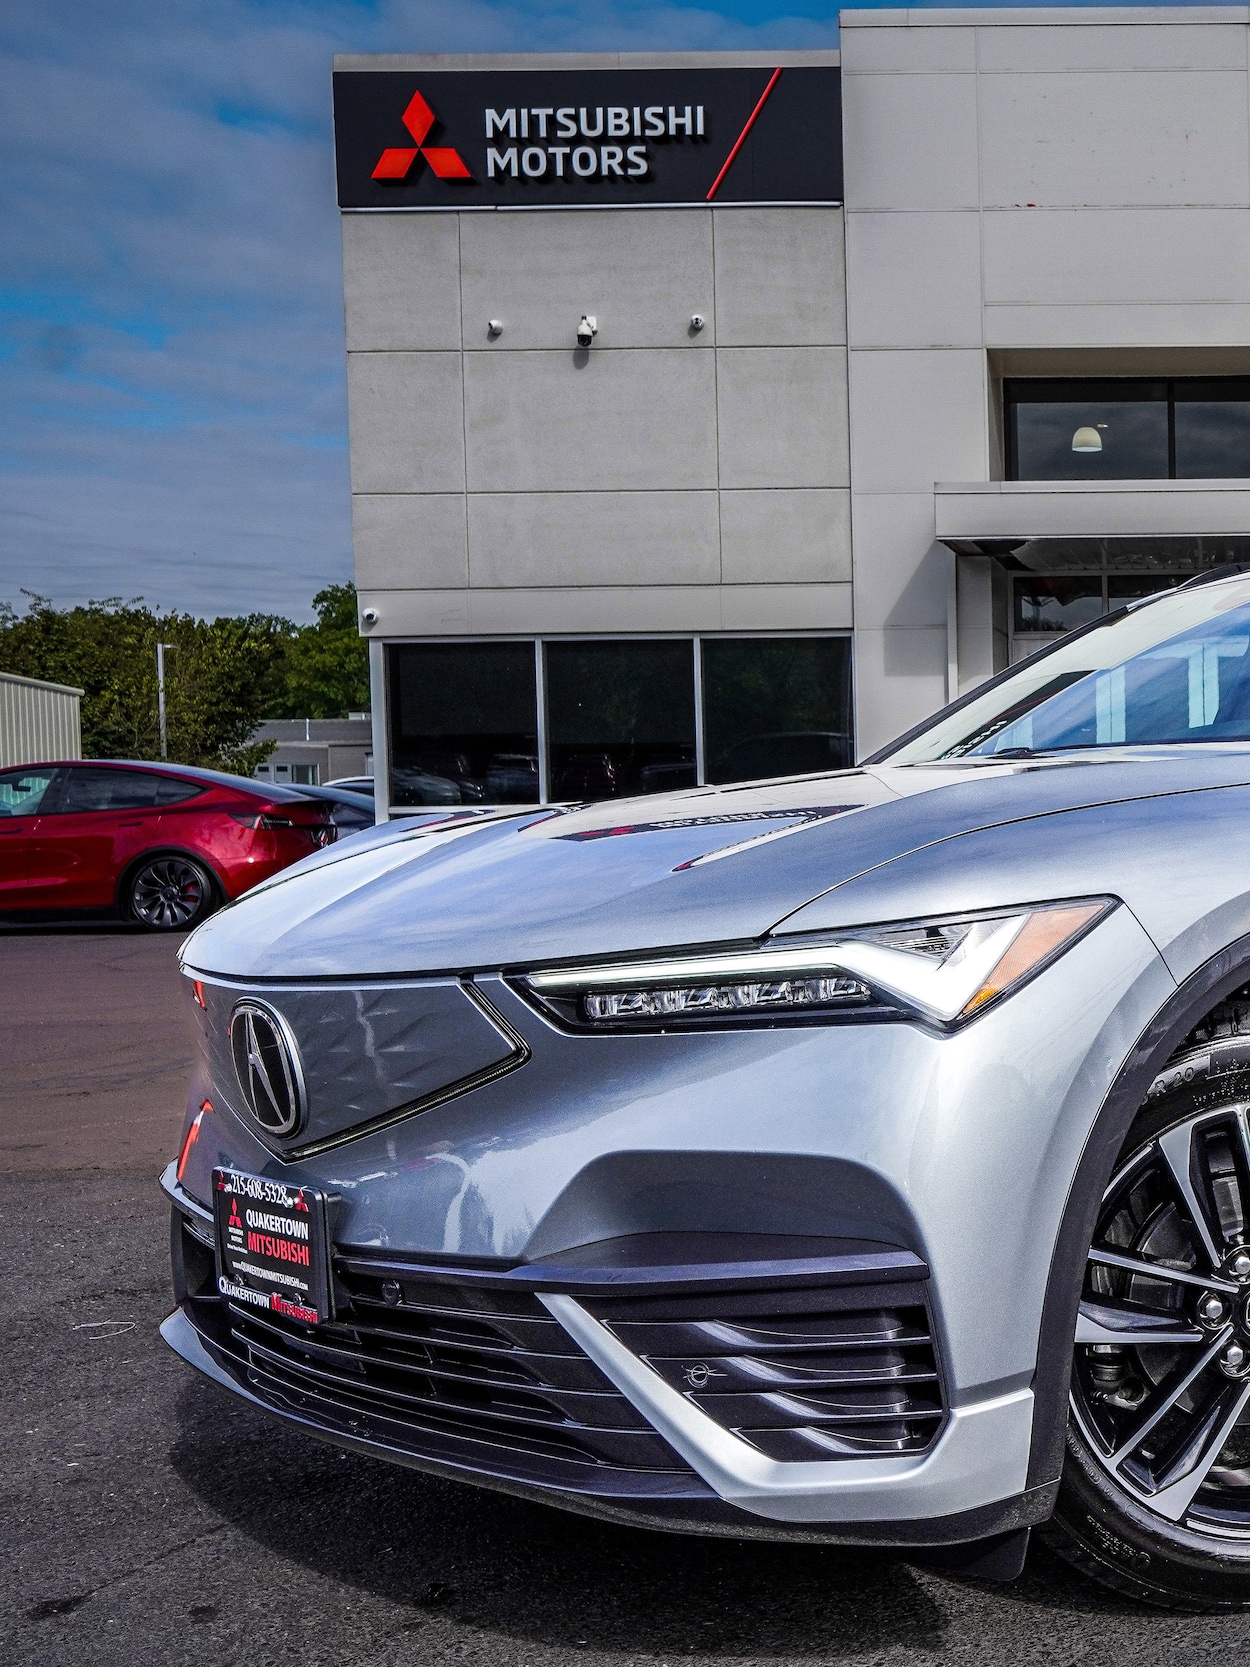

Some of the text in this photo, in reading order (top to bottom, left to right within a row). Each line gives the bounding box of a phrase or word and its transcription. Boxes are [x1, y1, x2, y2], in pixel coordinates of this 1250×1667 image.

[485, 105, 705, 139] MITSUBISHI
[486, 144, 649, 178] MOTORS
[231, 1175, 288, 1205] 215-608-5328
[246, 1209, 309, 1240] QUAKERTOWN
[248, 1232, 309, 1266] MITSUBISHI
[219, 1278, 318, 1324] QUAKERTOWN MITSUBISHI
